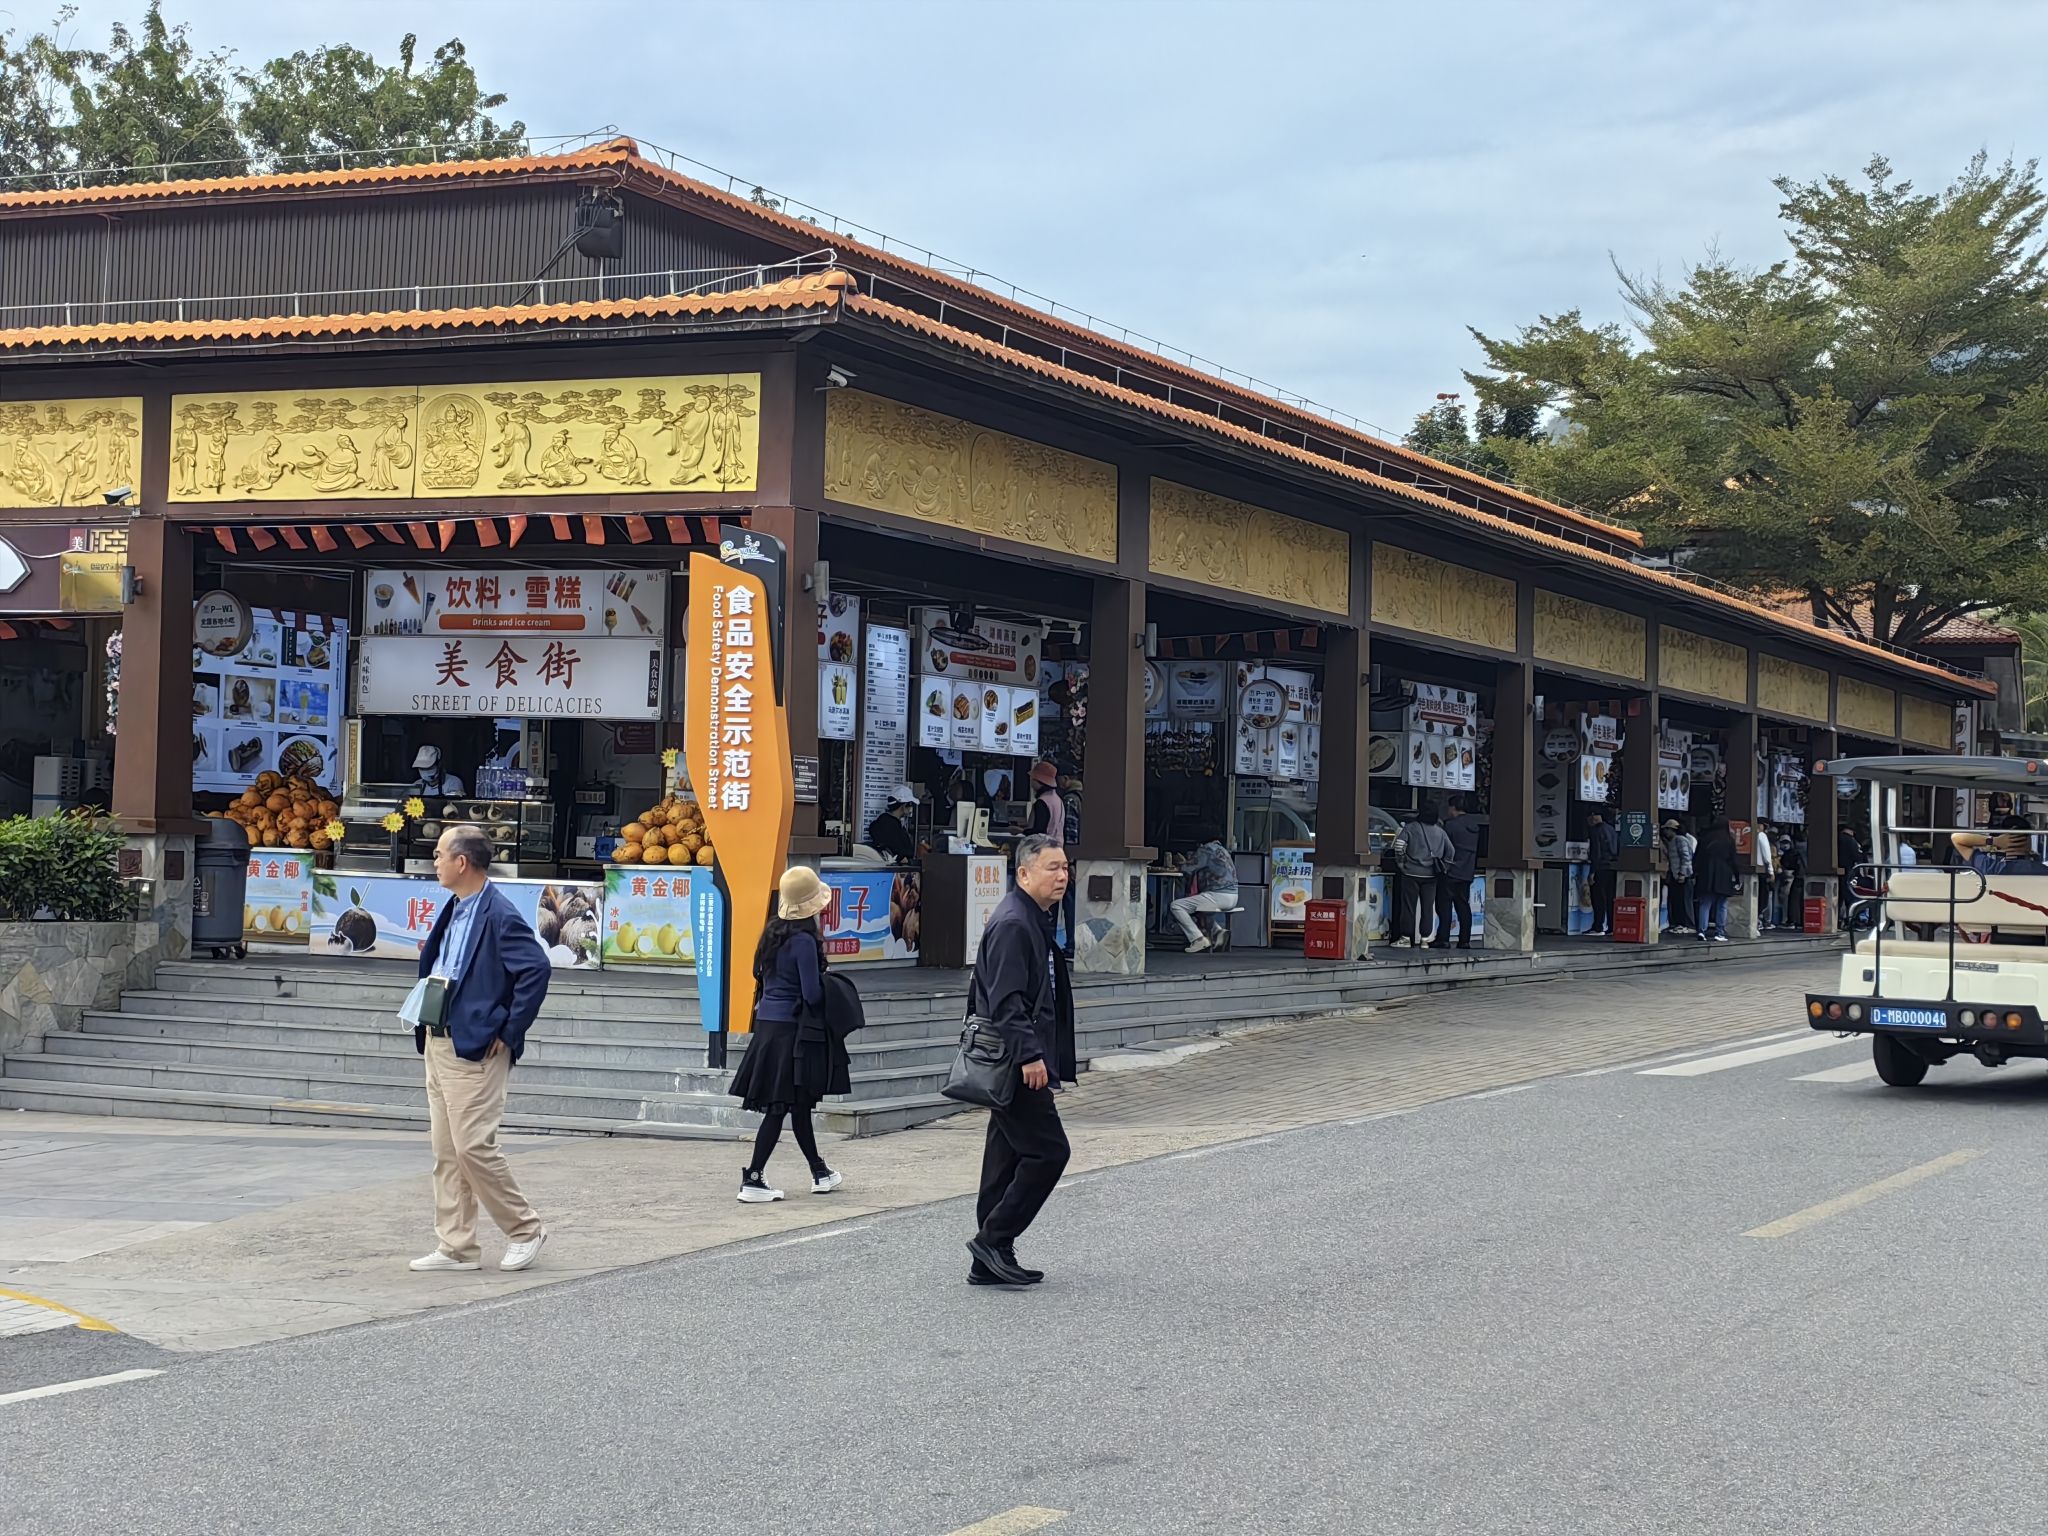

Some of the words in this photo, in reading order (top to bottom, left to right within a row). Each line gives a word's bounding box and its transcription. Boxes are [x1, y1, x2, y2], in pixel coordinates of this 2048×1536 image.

[445, 575, 582, 609] 饮料·雪糕
[712, 585, 724, 618] Food
[472, 617, 497, 627] Drinks
[498, 618, 513, 627] and
[514, 618, 526, 627] ice
[527, 619, 551, 627] cream
[710, 621, 723, 664] Safety
[361, 655, 371, 694] 风味特色
[434, 639, 582, 690] 美食街
[411, 694, 472, 711] STREET
[477, 695, 499, 712] OF
[505, 696, 603, 714] DELICACIES
[720, 585, 755, 811] 食品安全示范街
[708, 667, 722, 766] Demonstration
[707, 768, 720, 809] Street
[247, 860, 300, 879] 黄金椰
[631, 876, 691, 898] 黄金椰
[974, 887, 1000, 897] CASHIER
[1873, 1008, 1946, 1026] D-MB000040
